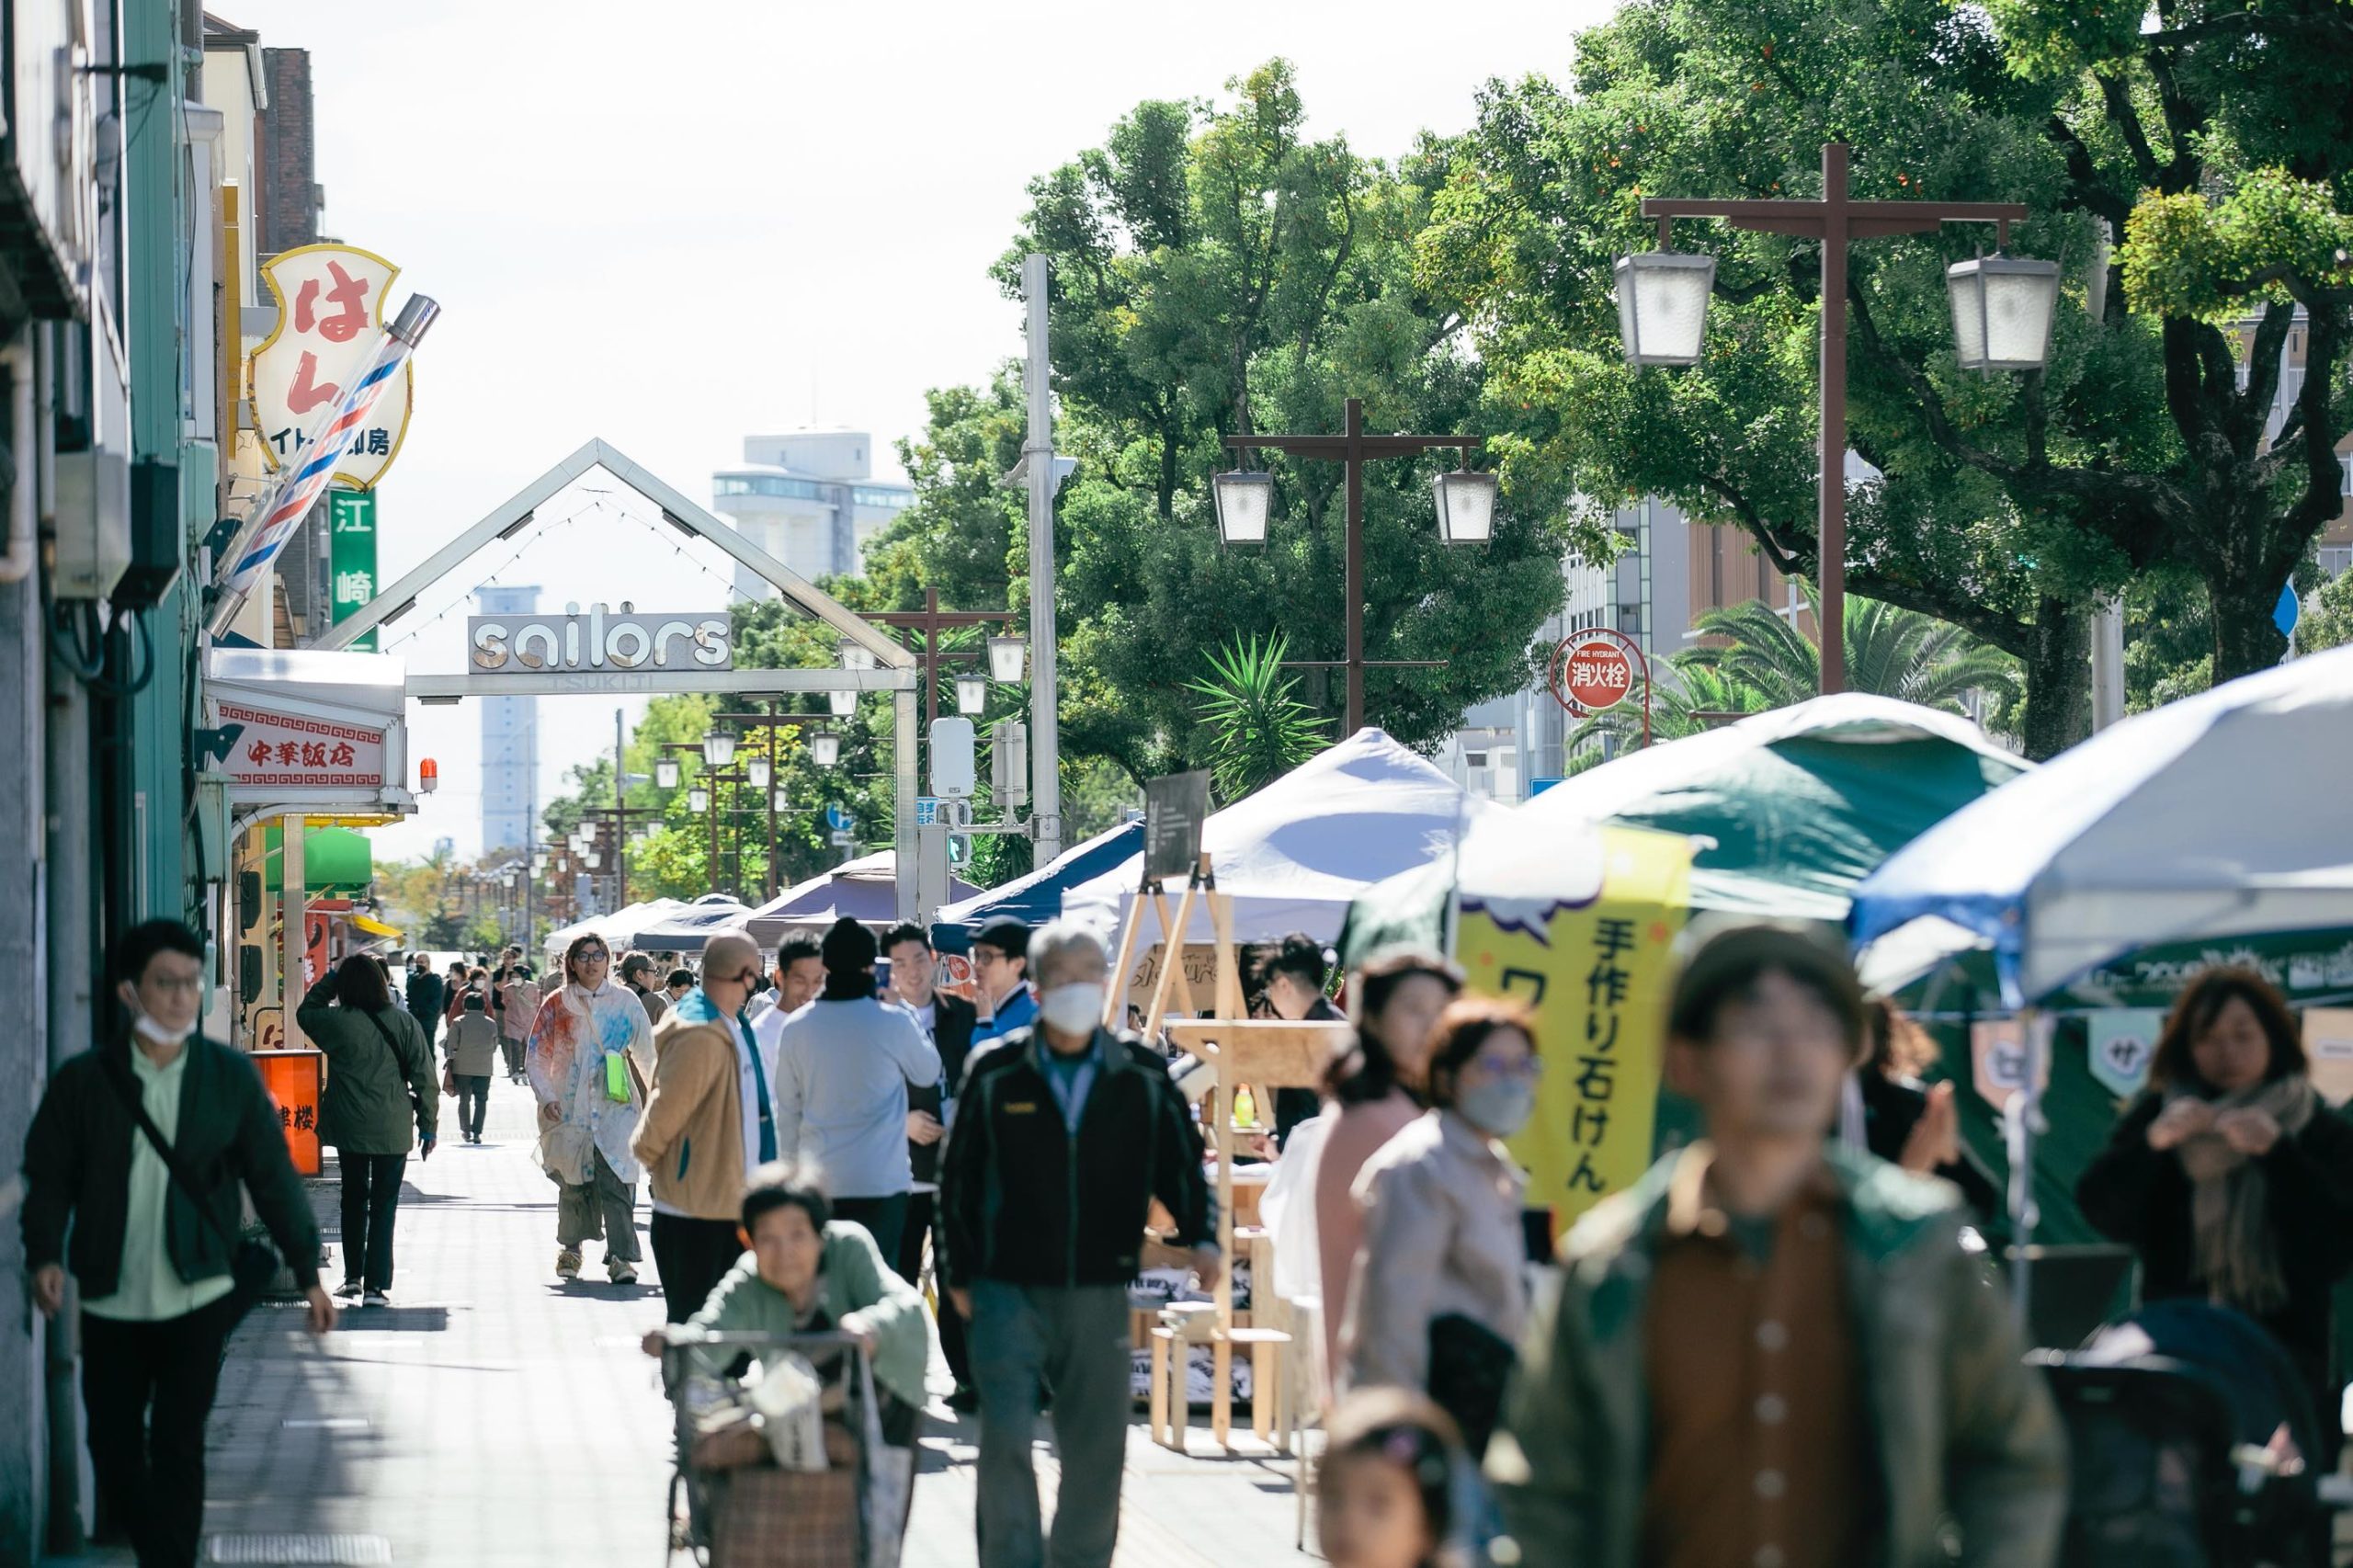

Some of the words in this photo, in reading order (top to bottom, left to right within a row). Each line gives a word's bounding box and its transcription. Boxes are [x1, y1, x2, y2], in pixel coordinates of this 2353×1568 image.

[287, 259, 369, 415] はん
[472, 600, 729, 669] sailors
[1576, 650, 1591, 658] FIRE
[1592, 650, 1620, 658] HYDRANT
[1572, 662, 1627, 687] 消火栓
[247, 739, 356, 768] 中華飯店
[1567, 918, 1637, 1193] 手作り石けん
